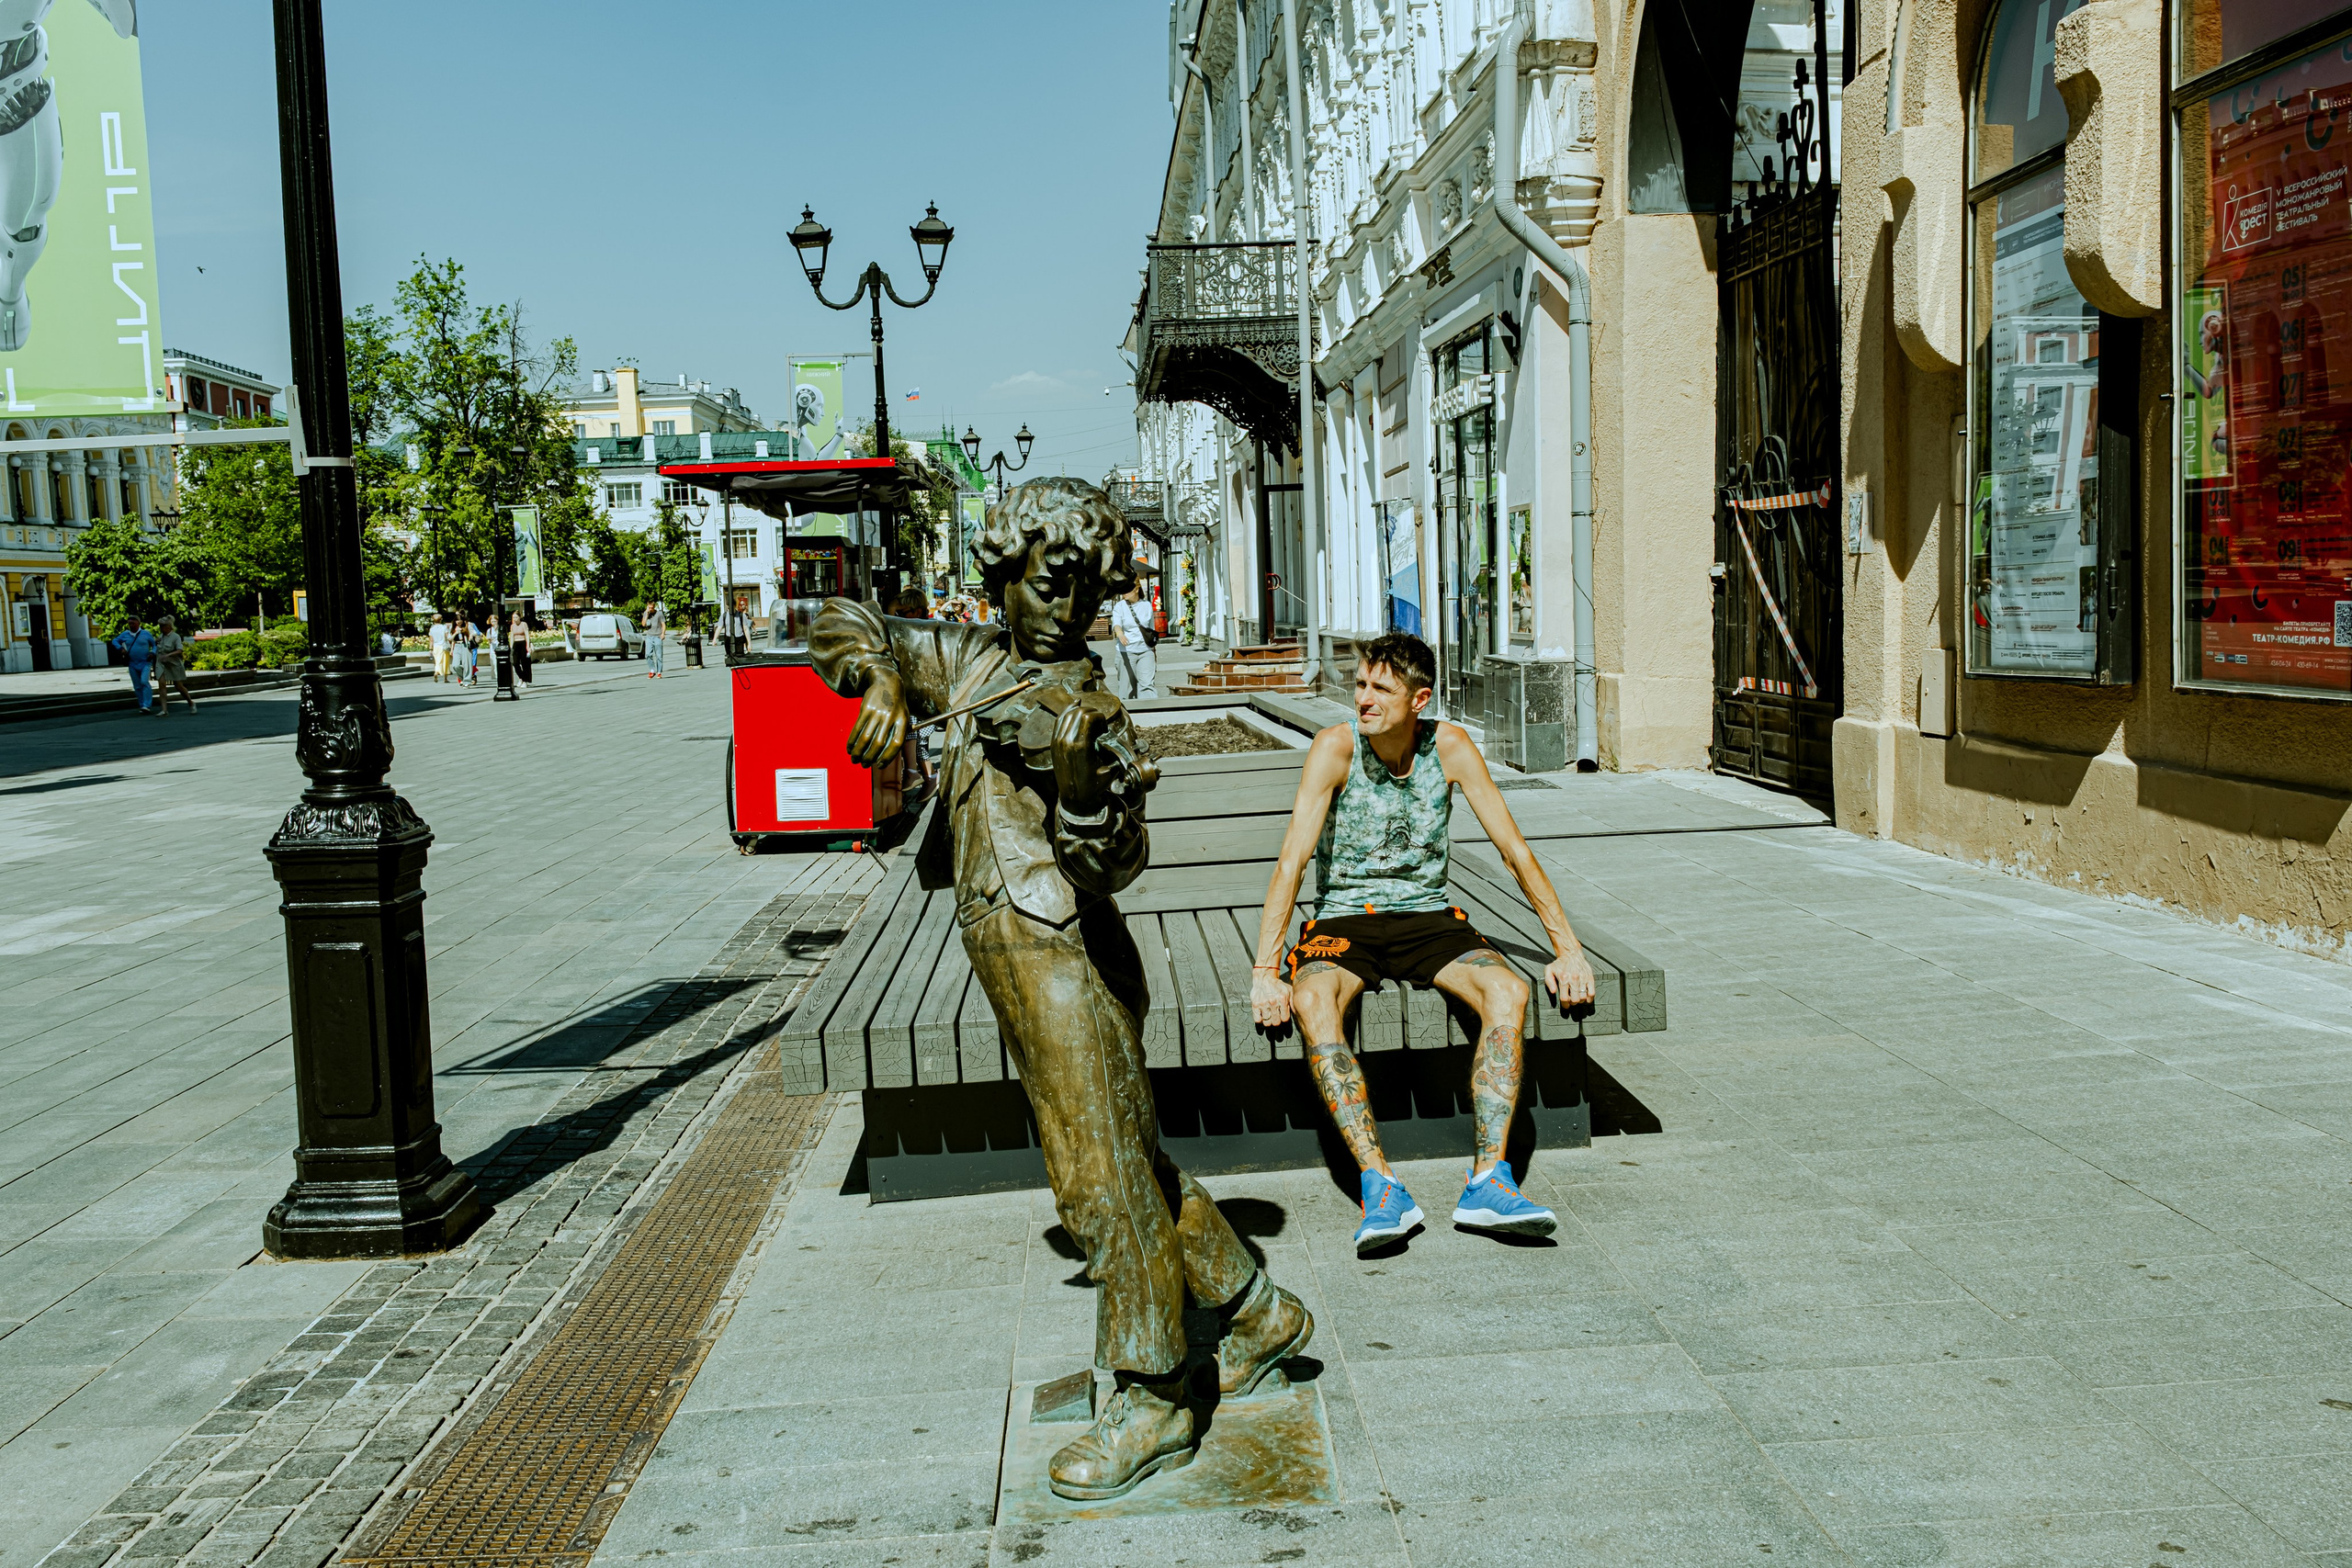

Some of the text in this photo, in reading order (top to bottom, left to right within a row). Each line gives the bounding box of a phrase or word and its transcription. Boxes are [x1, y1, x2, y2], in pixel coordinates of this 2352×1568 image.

[2284, 165, 2348, 195] ВСЕРОССИЙСКИЙ
[2276, 179, 2343, 209] МОНОЖАНРОВЫЙ
[2276, 196, 2329, 220] ТЕАТРАЛЬНЫЙ
[2276, 213, 2318, 232] ФЕСТИВАЛЬ
[2252, 633, 2331, 646] ТЕАТР-КОМЕДИЯ.РФ
